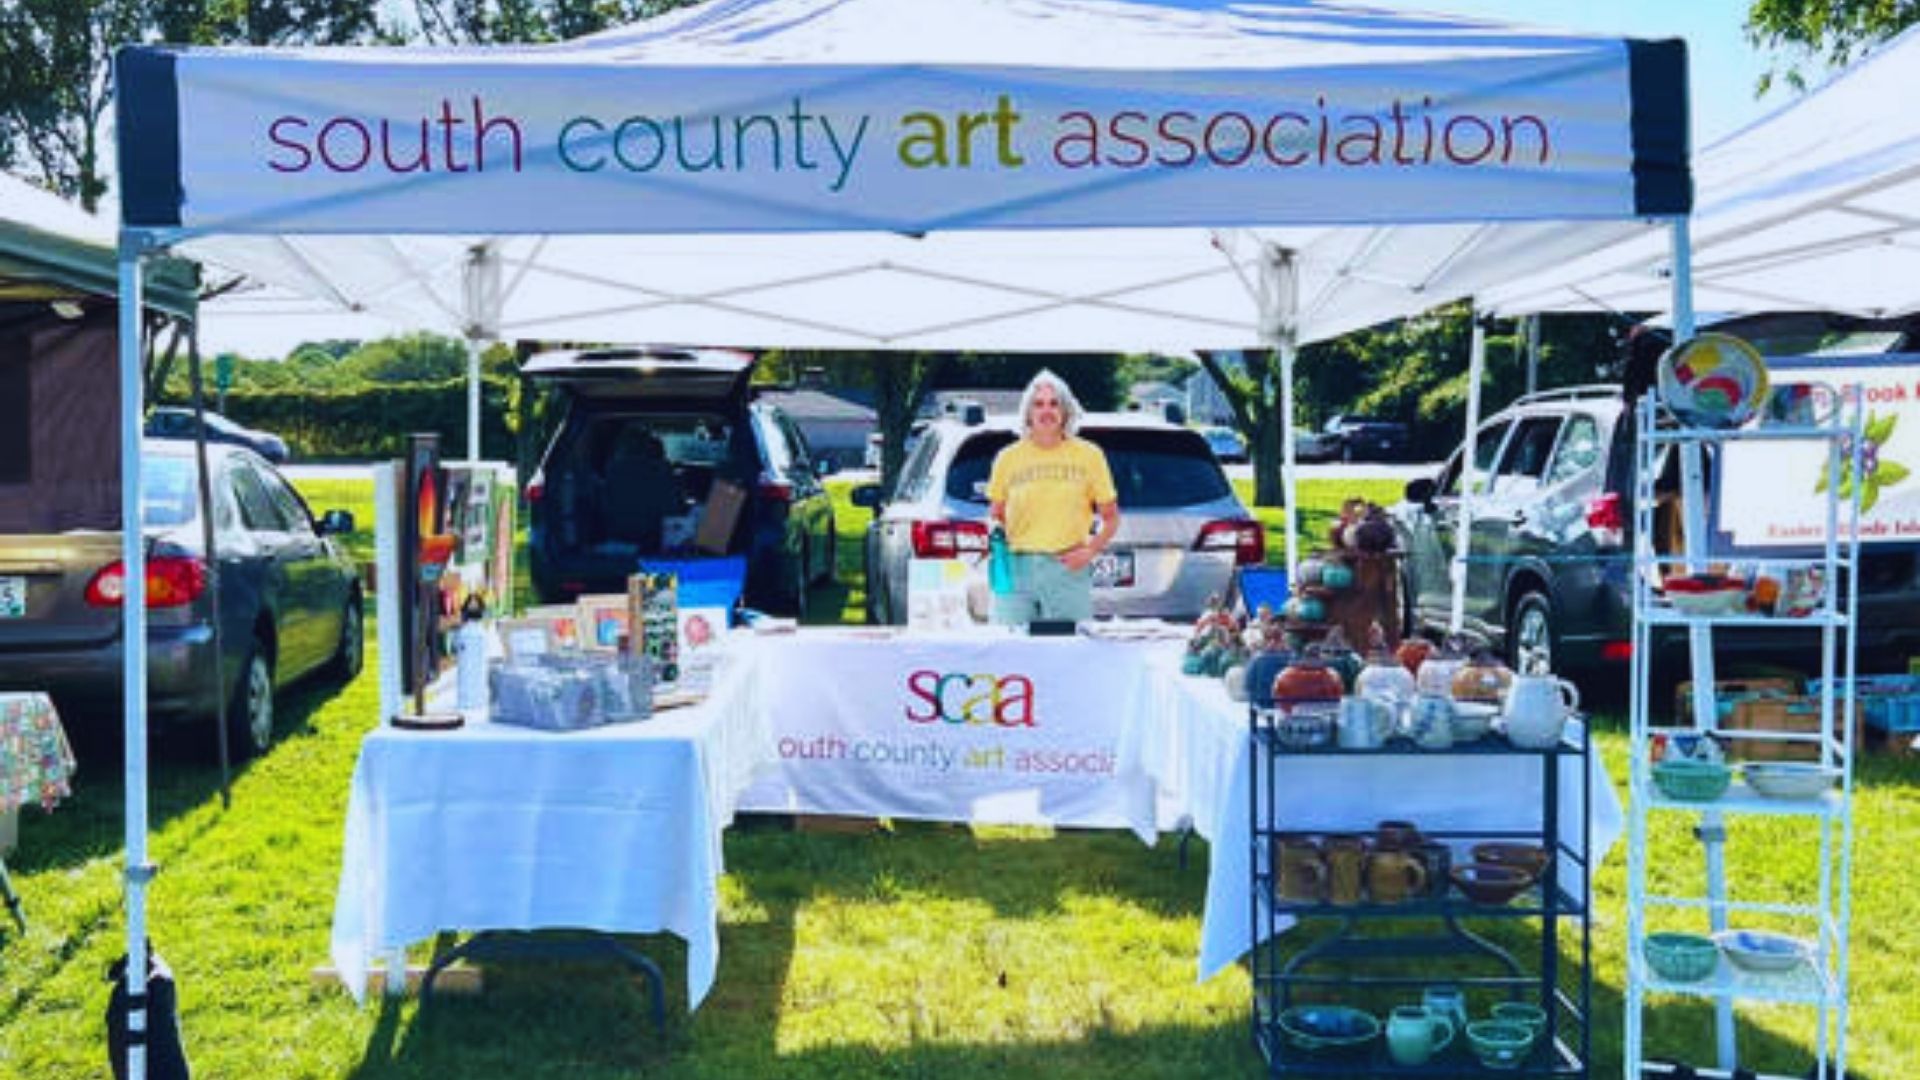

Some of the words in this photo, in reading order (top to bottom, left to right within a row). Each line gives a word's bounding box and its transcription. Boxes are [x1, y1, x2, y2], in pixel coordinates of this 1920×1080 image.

[268, 96, 522, 173] south
[557, 98, 869, 191] county
[898, 95, 1023, 168] art
[1053, 97, 1550, 168] association
[905, 670, 1036, 728] scaa
[853, 740, 953, 772] county
[963, 746, 1005, 769] art
